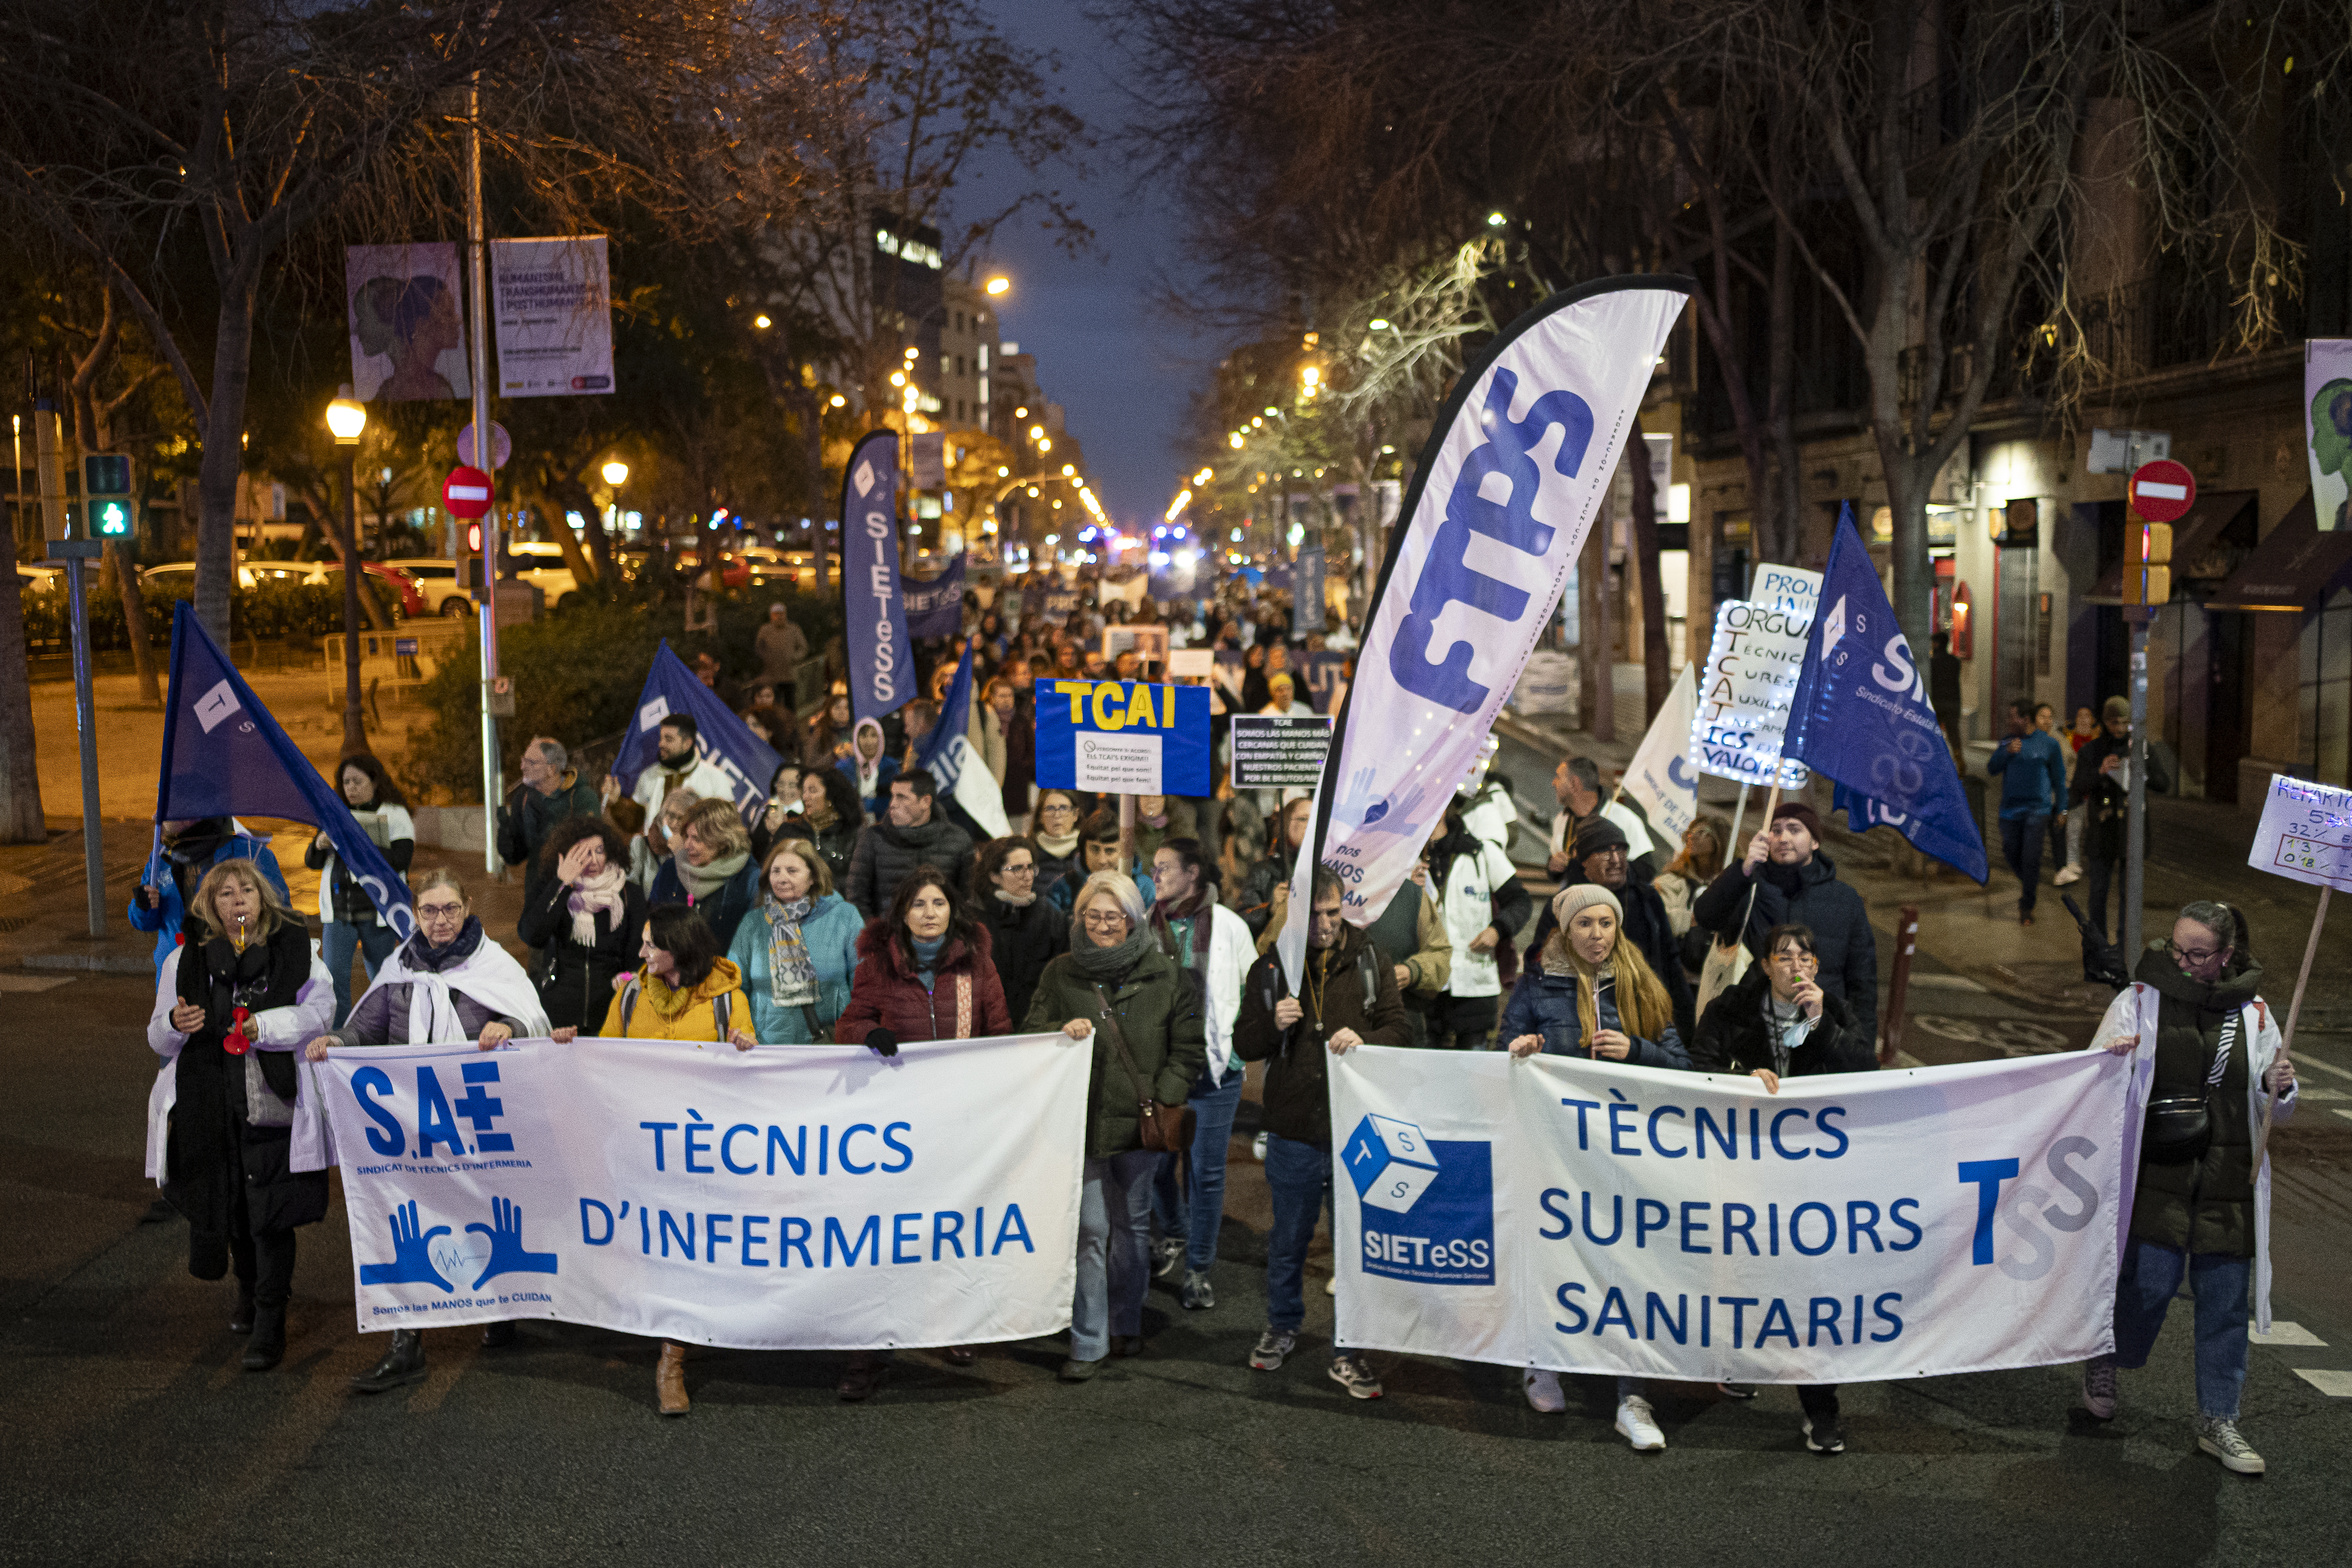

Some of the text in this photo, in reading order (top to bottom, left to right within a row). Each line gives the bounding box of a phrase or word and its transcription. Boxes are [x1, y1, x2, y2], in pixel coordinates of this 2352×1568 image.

[1599, 409, 1624, 472] FEDERACIÓN
[1593, 478, 1599, 490] DE
[1389, 366, 1595, 714] FTPS
[866, 511, 896, 702] SIETeSS
[1727, 606, 1810, 639] ORGU
[1521, 650, 1528, 662] DE
[208, 694, 226, 712] T
[1055, 681, 1176, 731] TCAI
[1855, 685, 1904, 715] Sindicato
[1236, 730, 1265, 738] SOMOS
[1087, 764, 1109, 772] Equitat
[1235, 752, 1253, 760] CON
[1284, 763, 1322, 772] PACIENTE
[1087, 775, 1109, 783] Equitat
[1111, 776, 1121, 784] pel
[1562, 1088, 1850, 1160] TÈCNICS
[640, 1108, 914, 1176] TÈCNICS
[1353, 1139, 1372, 1166] T
[1398, 1132, 1415, 1153] S
[357, 1160, 533, 1175] SINDICAT DE TÈCNICS D'INFERMERIA
[1390, 1181, 1411, 1199] S
[1539, 1188, 1923, 1257] SUPERIORS
[1365, 1230, 1490, 1268] SIETeSS
[373, 1293, 552, 1316] Somos las MANOS que te CUIDAN
[1556, 1282, 1904, 1350] SANITARIS
